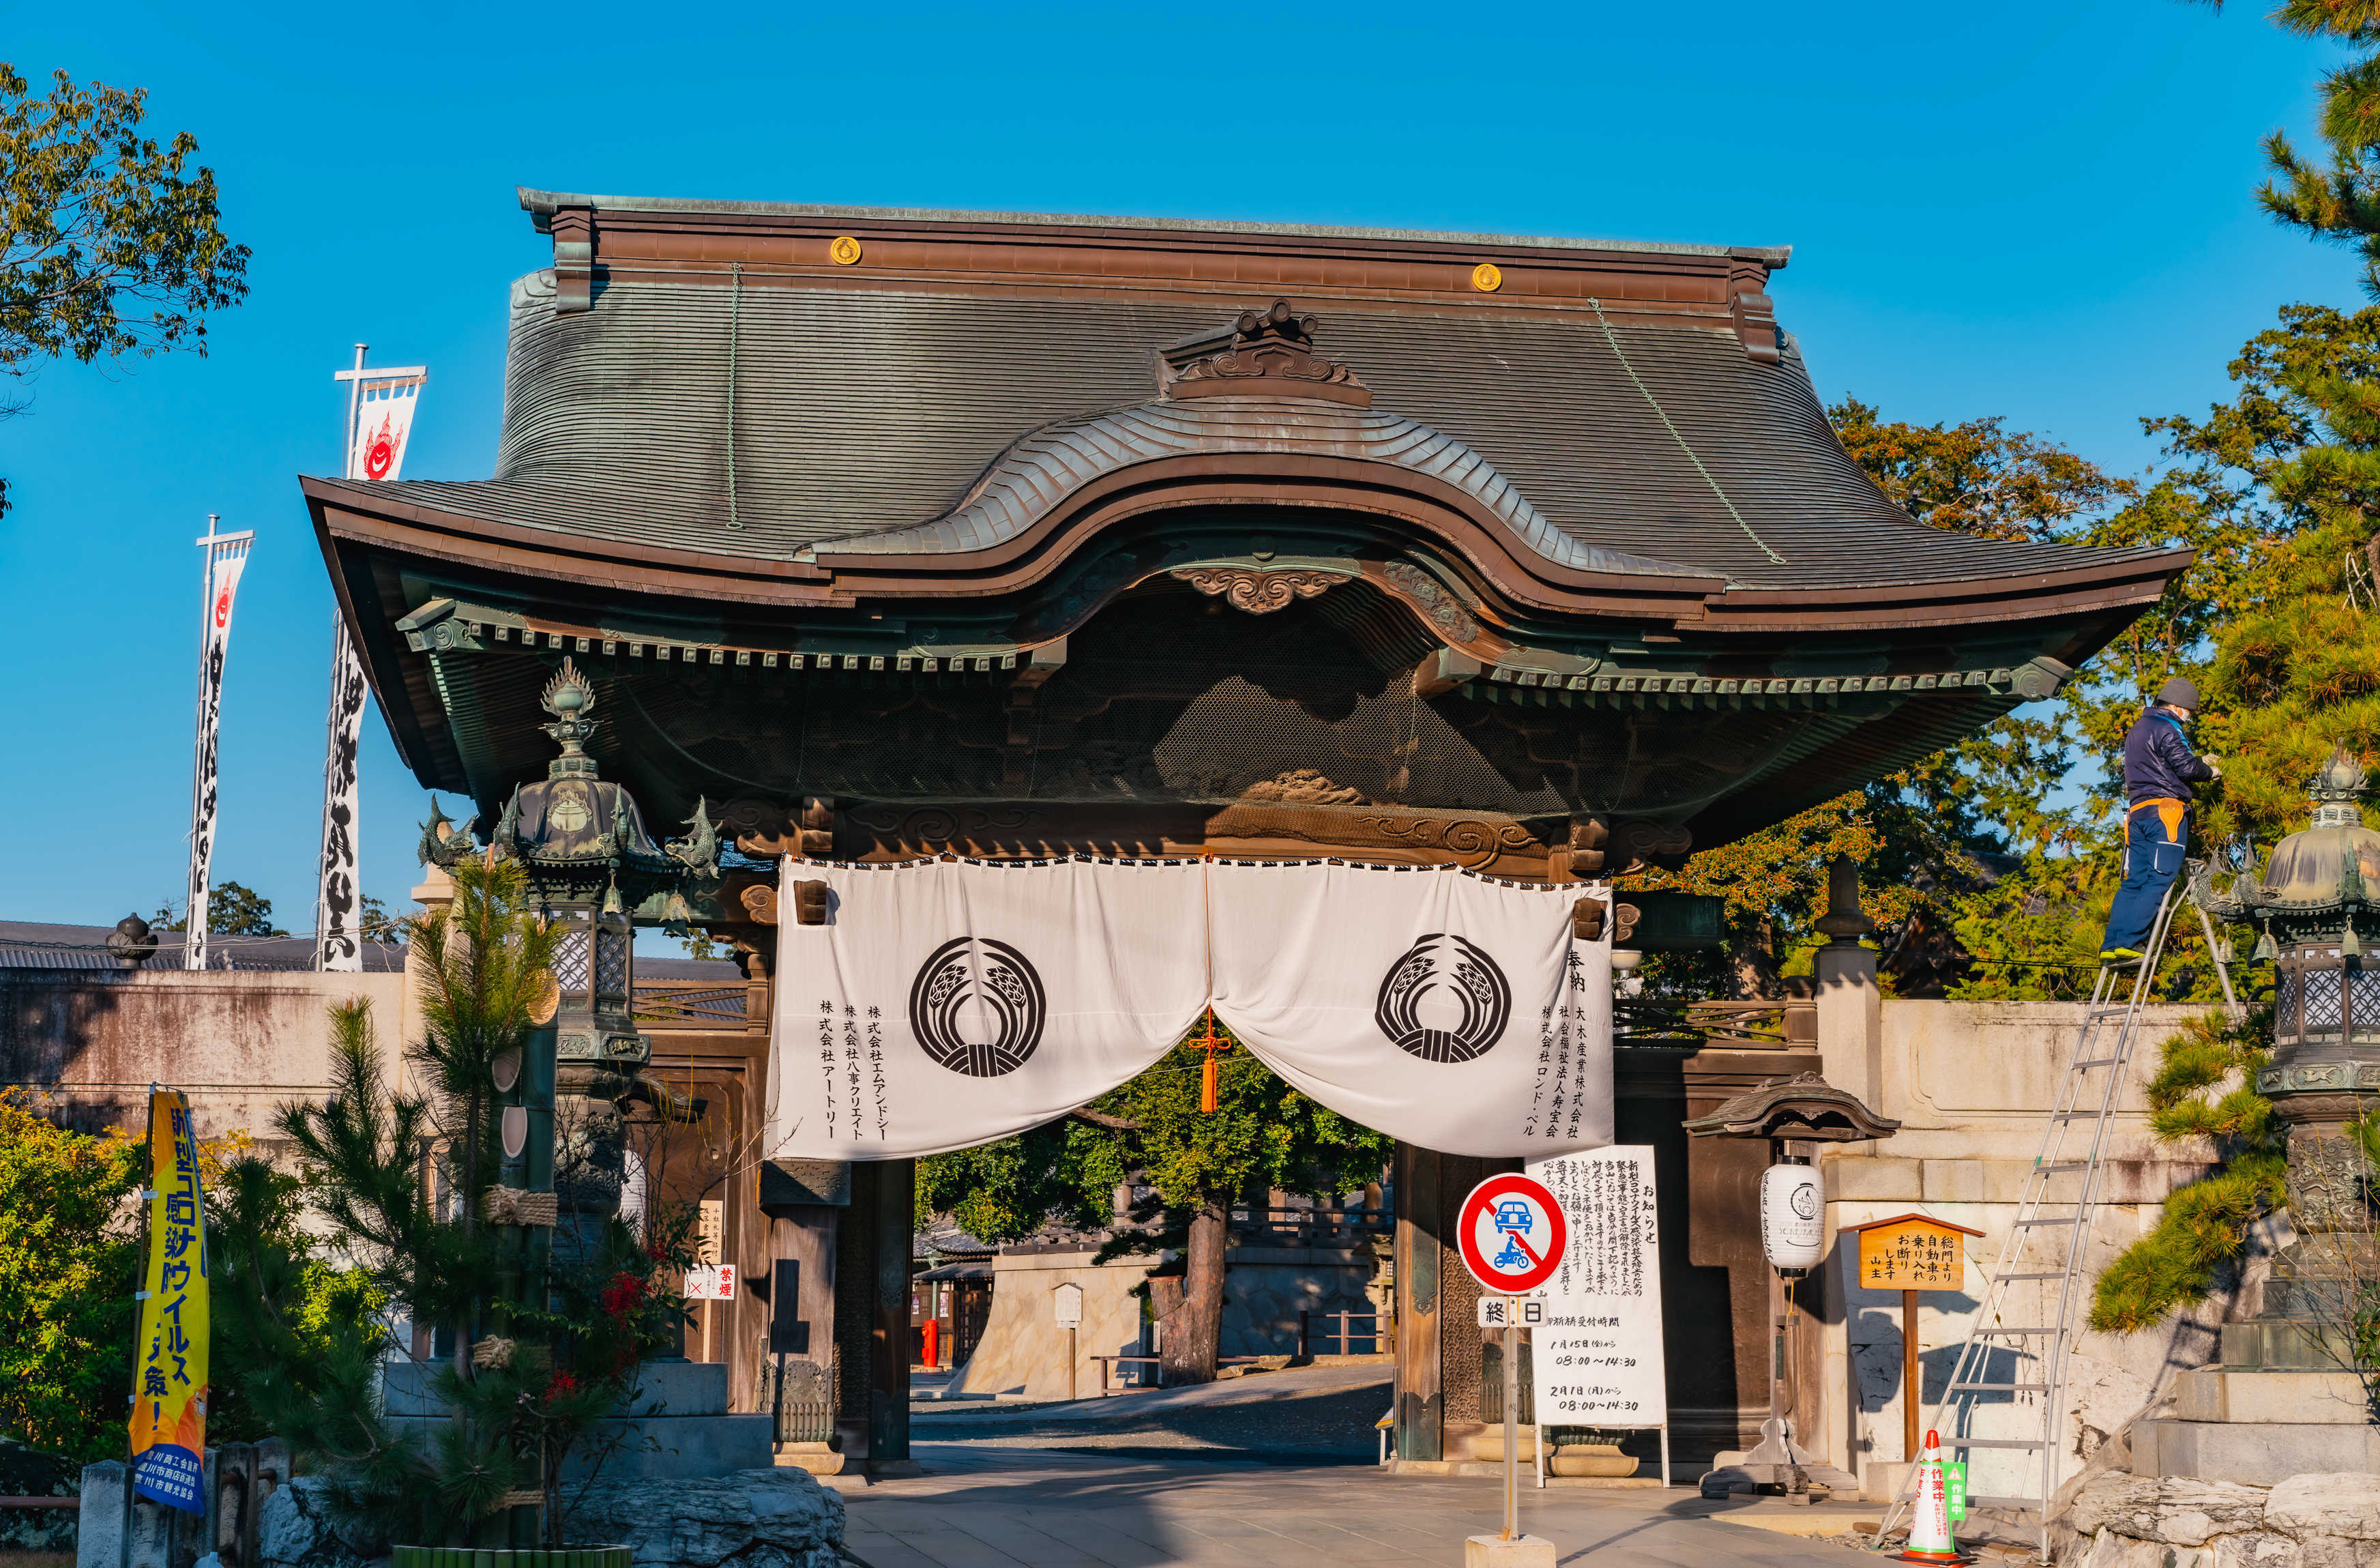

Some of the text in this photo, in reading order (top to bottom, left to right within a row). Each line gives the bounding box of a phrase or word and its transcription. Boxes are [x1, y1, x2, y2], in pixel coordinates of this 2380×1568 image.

[1568, 950, 1585, 993] 奉納
[819, 1000, 836, 1139] 株式会社アートリー
[844, 1004, 863, 1140] 株式会社八事クリエイト
[868, 1006, 889, 1141] 株式会社エムアンドシー
[1545, 1005, 1570, 1139] 社会福祉法人寿宝会
[1566, 1006, 1587, 1139] 大木産業株式会社
[1642, 1185, 1656, 1244] お知らせ
[1870, 1256, 1881, 1279] 山主
[1884, 1248, 1896, 1281] します
[1897, 1234, 1910, 1270] お断り
[1911, 1234, 1926, 1281] 乗り入れ
[1926, 1234, 1939, 1282] 自動車の
[1941, 1236, 1954, 1282] 総門より
[719, 1267, 733, 1296] 禁煙
[1486, 1302, 1541, 1323] 終日
[134, 1473, 193, 1500] 豊川市観光協会
[1932, 1468, 1945, 1502] 作業中
[1952, 1483, 1963, 1515] 作業中
